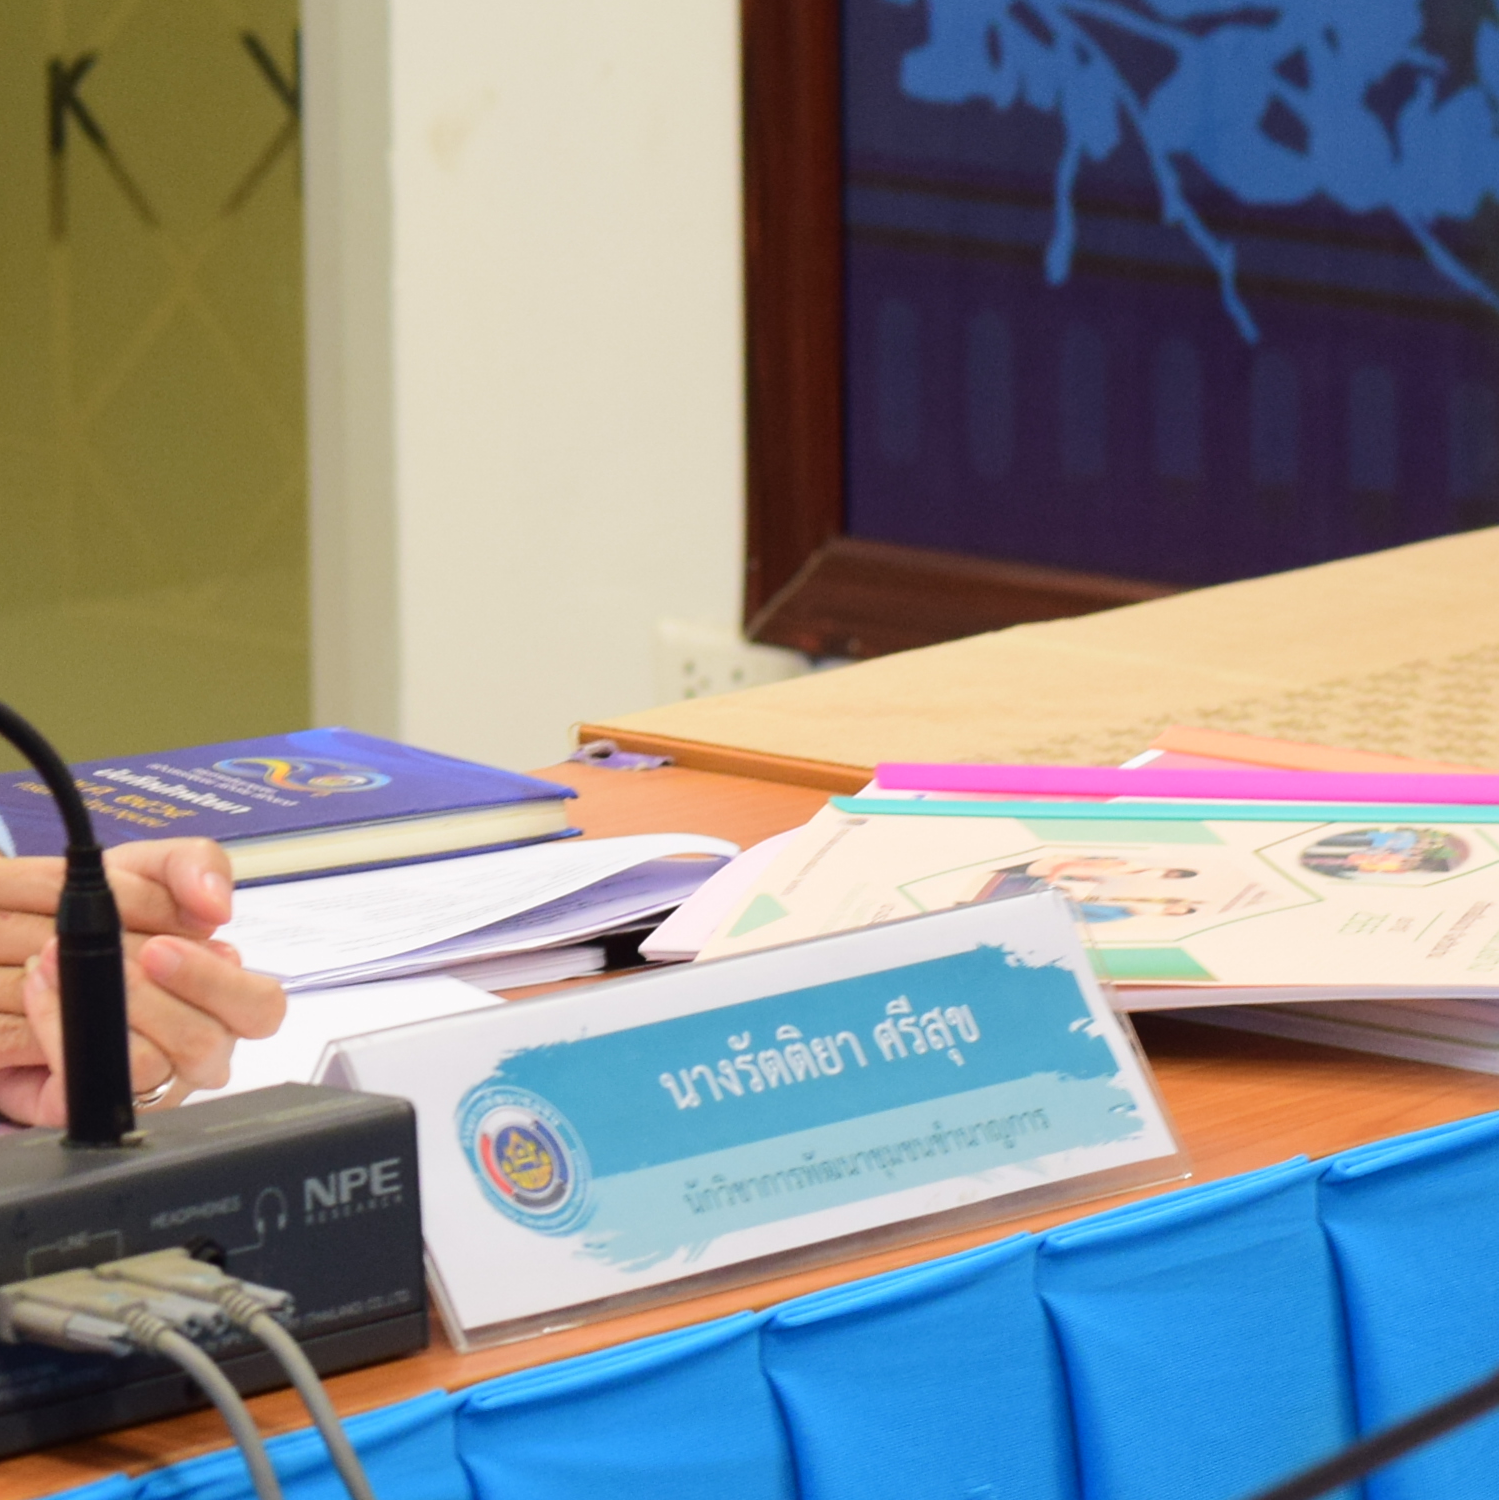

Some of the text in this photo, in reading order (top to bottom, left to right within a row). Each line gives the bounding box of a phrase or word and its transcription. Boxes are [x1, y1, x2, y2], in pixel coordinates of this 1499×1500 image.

[659, 994, 981, 1110] นางรัตติยา ศรีสุข
[304, 1157, 402, 1212] NPE
[681, 1107, 1052, 1214] นักวิชาการพัฒนาชุมชนชำนาญการ
